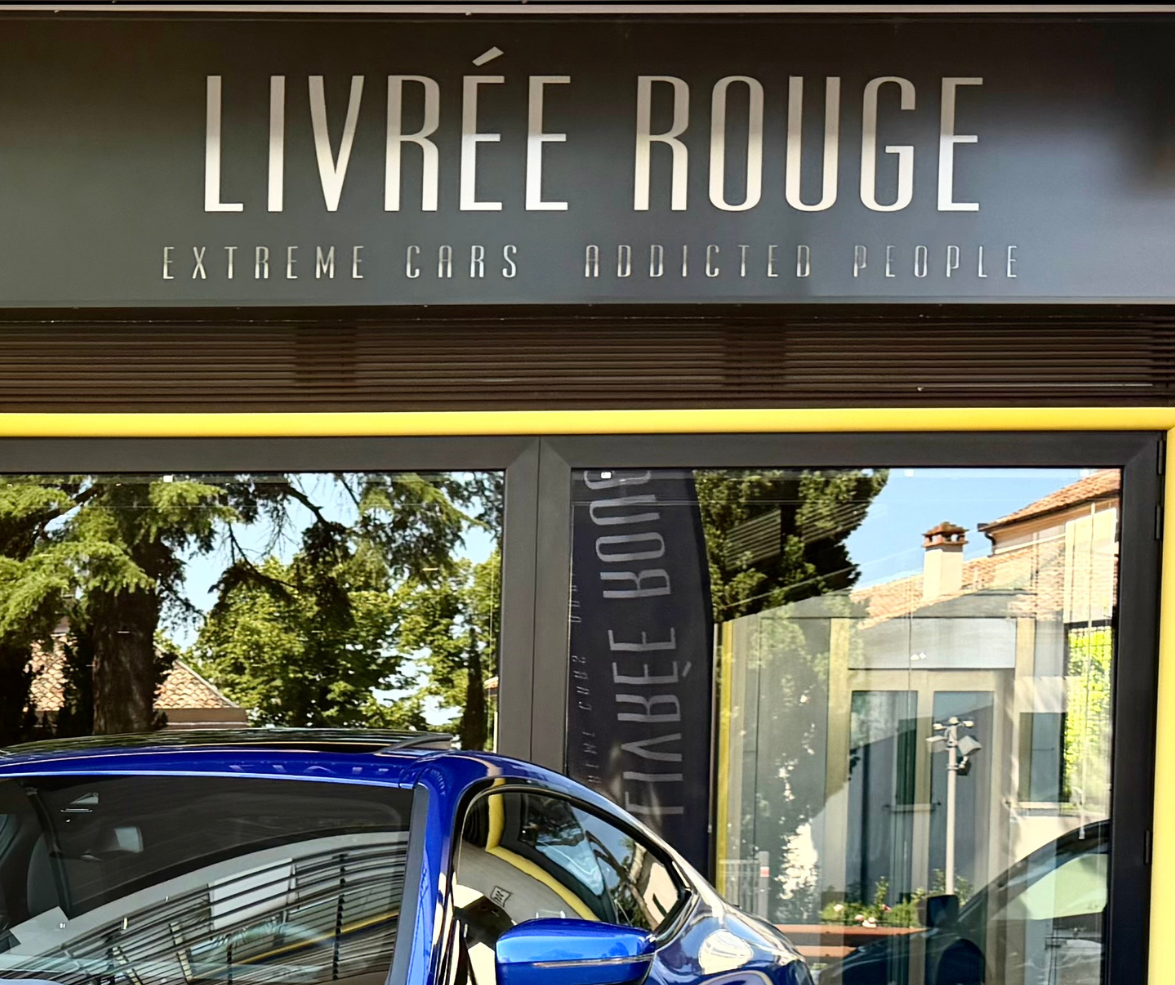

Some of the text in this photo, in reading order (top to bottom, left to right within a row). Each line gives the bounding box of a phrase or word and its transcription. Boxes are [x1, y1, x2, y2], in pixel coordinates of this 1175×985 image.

[204, 46, 984, 212] LIVRÉE ROUGE
[163, 244, 1018, 280] EXTREME CARS ADDICTED PEOPLE
